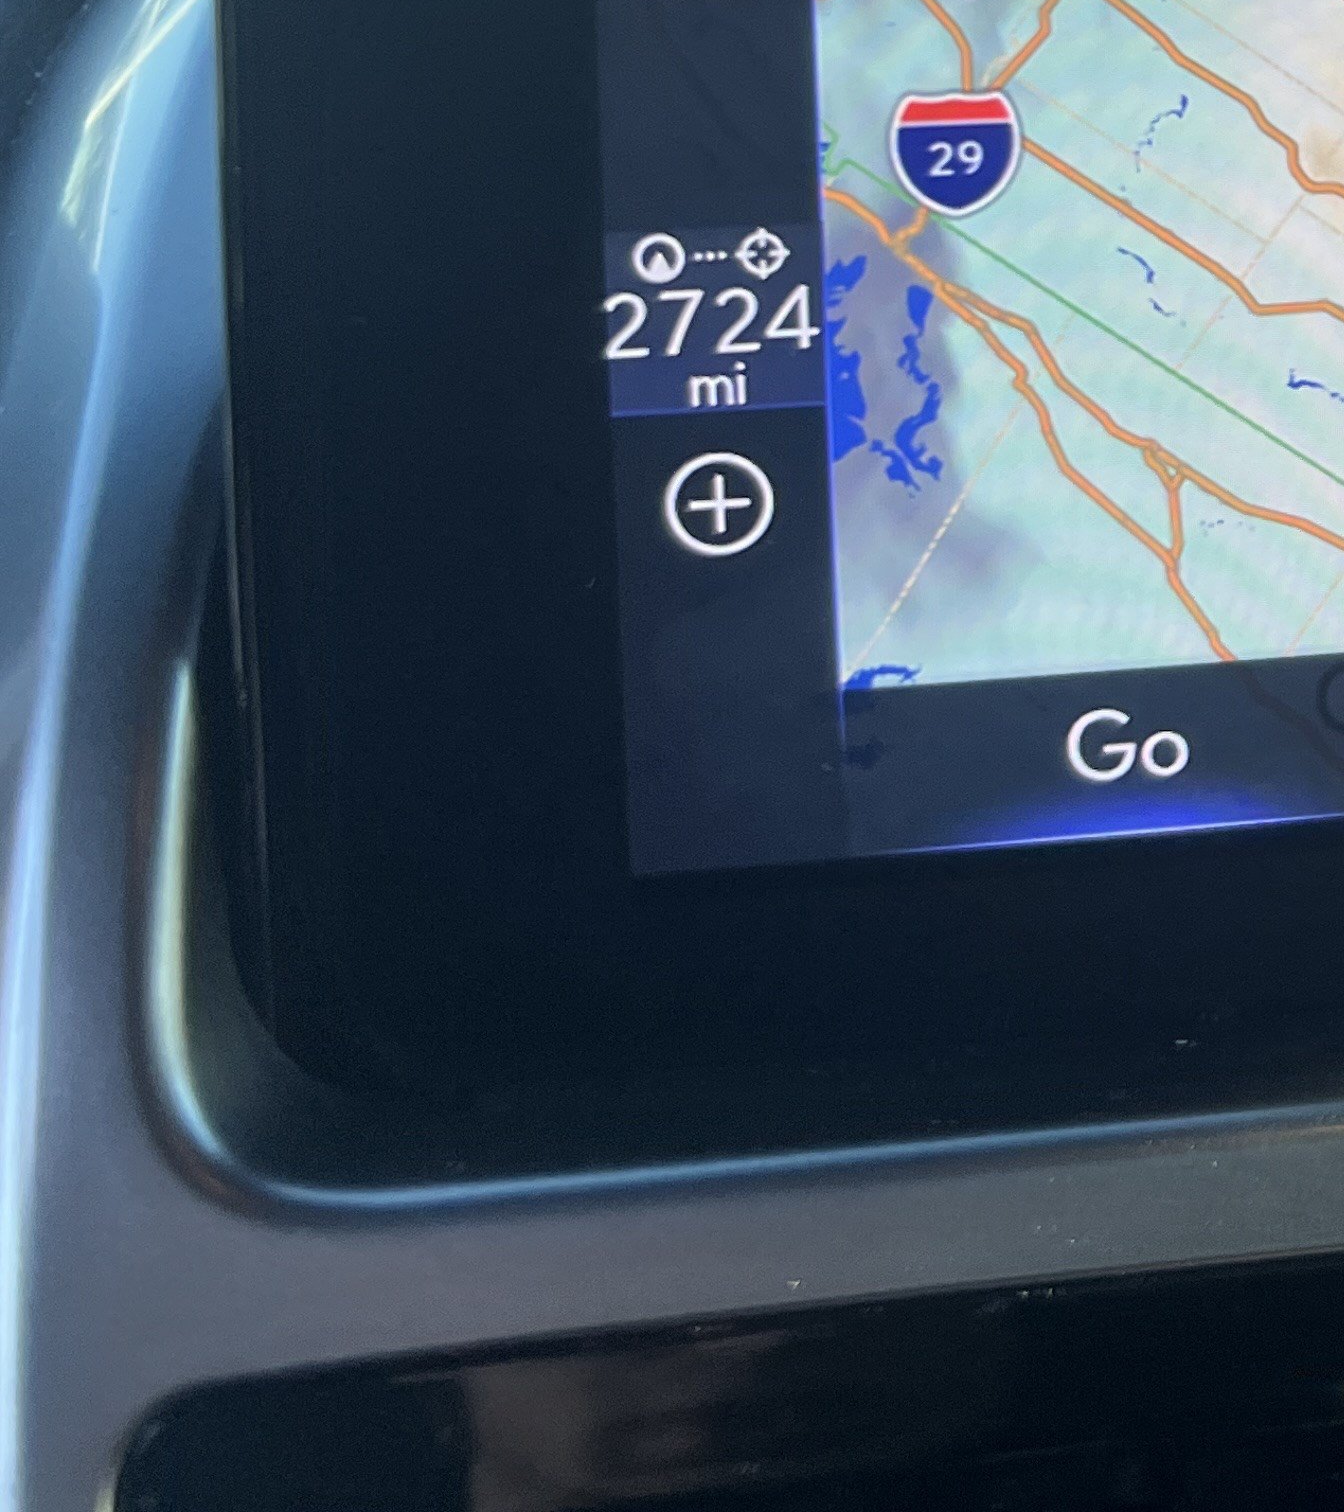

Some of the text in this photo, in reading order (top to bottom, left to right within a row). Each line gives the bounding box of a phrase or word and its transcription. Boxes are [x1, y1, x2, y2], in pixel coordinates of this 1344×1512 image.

[928, 141, 984, 178] 29
[603, 284, 820, 360] 2724
[690, 363, 747, 408] mi
[1066, 708, 1190, 782] Go
